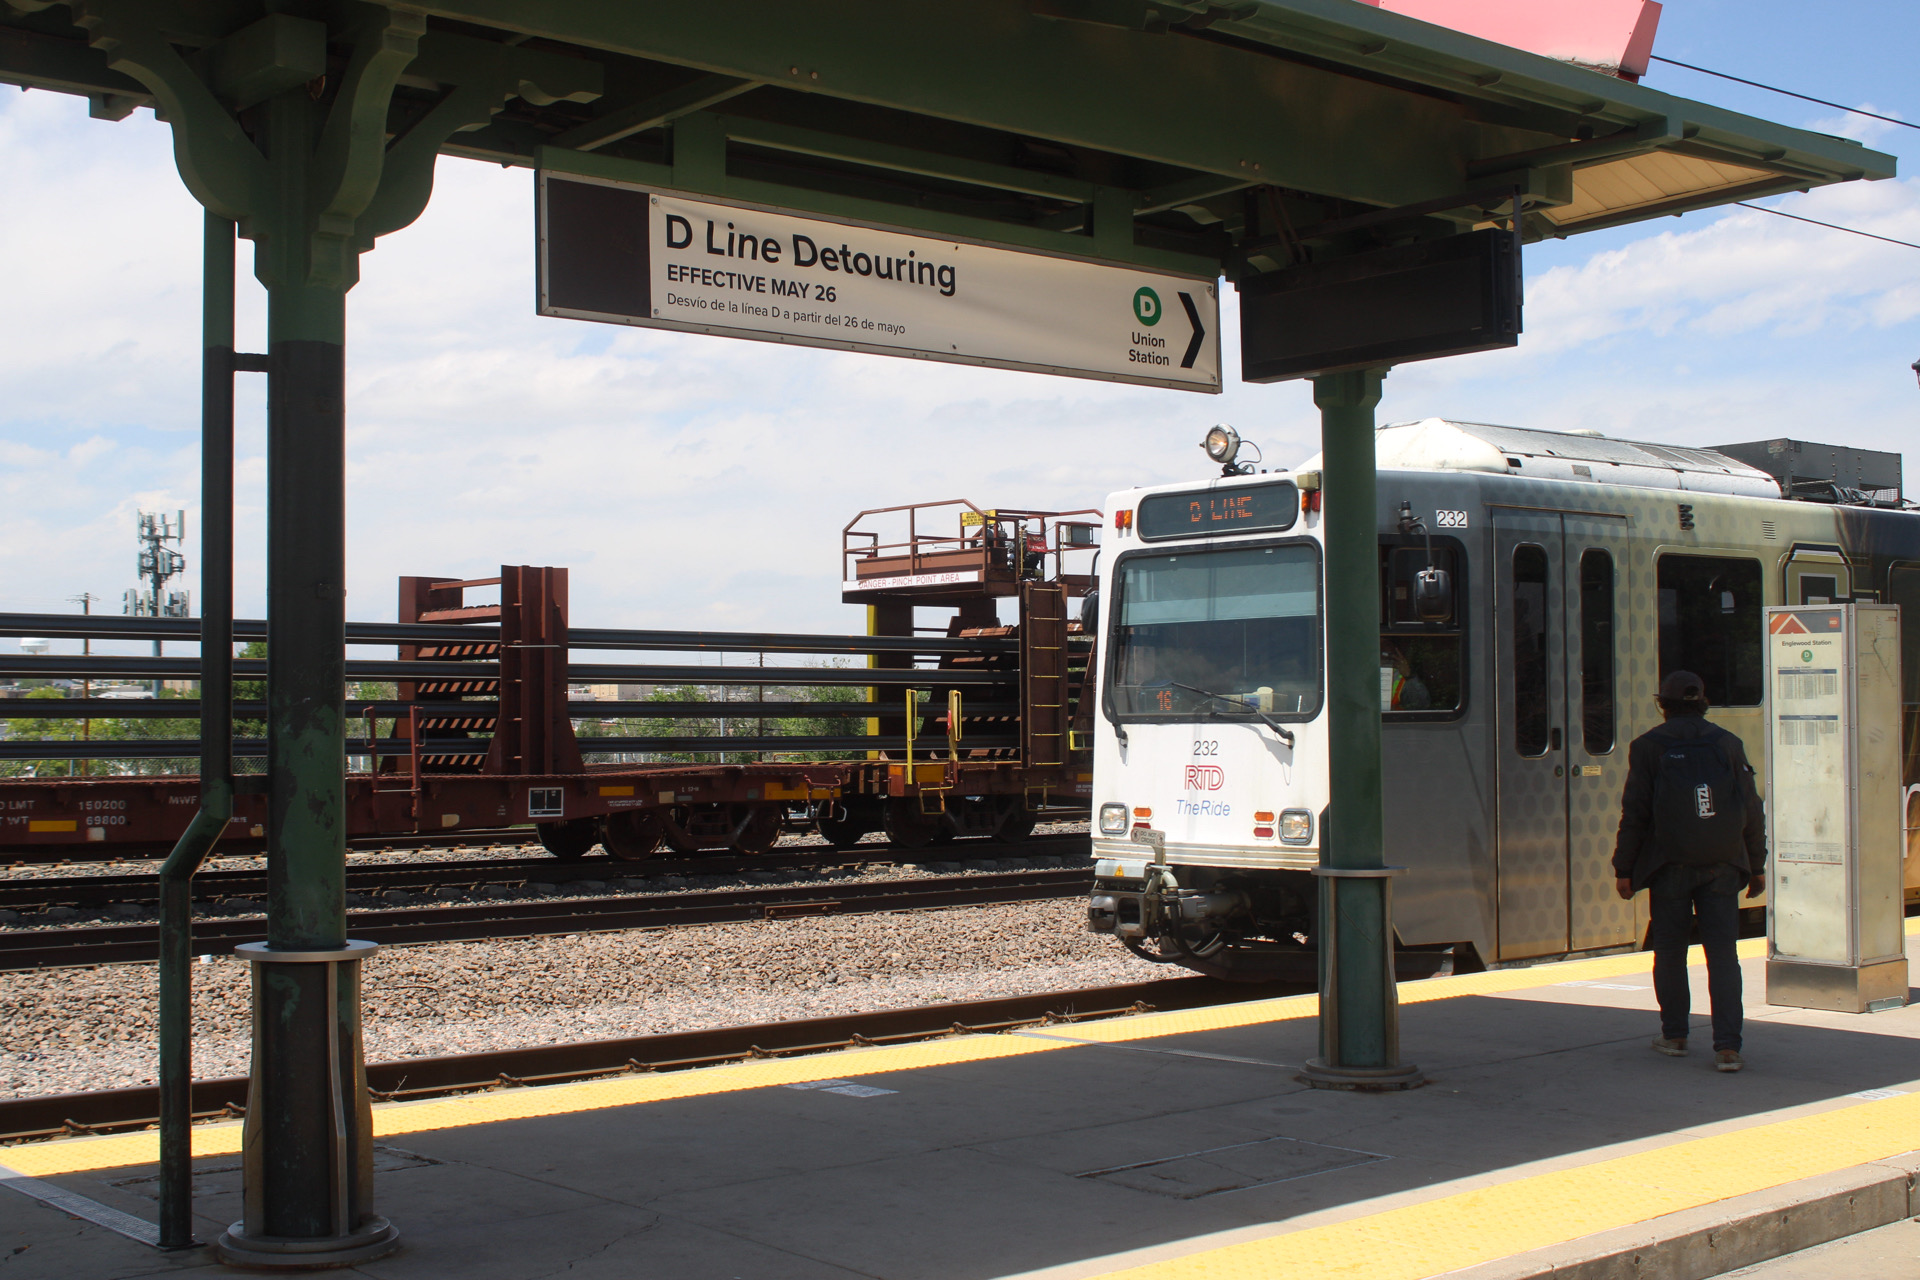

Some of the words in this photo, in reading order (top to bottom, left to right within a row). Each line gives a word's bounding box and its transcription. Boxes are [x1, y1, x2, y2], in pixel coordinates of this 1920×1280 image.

[666, 214, 693, 249] D
[706, 220, 781, 263] Line
[793, 234, 956, 297] Detouring
[667, 264, 766, 293] EFFECTIVE
[771, 278, 810, 300] MAY
[815, 285, 837, 303] 26
[667, 293, 707, 310] Desvío
[710, 298, 725, 312] de
[729, 302, 738, 314] la
[741, 302, 768, 317] línea
[772, 306, 780, 318] D
[783, 310, 790, 319] a
[793, 310, 821, 325] partir
[825, 313, 841, 326] del
[844, 316, 858, 328] 26
[861, 318, 875, 330] de
[877, 321, 906, 335] mayo
[1140, 294, 1156, 318] D
[1131, 331, 1165, 348] Union
[1128, 349, 1170, 366] Station
[1211, 496, 1253, 521] LINE
[1437, 511, 1467, 527] 232
[858, 579, 888, 590] DANGER
[892, 576, 913, 587] PINCH
[916, 574, 937, 585] POINT
[940, 572, 960, 582] AREA
[1193, 741, 1219, 756] 232
[1184, 765, 1224, 791] RTD
[9, 800, 35, 810] LMT
[79, 800, 127, 811] 150200
[1696, 783, 1716, 818] PETZL
[7, 816, 30, 825] WT
[86, 816, 126, 825] 69800
